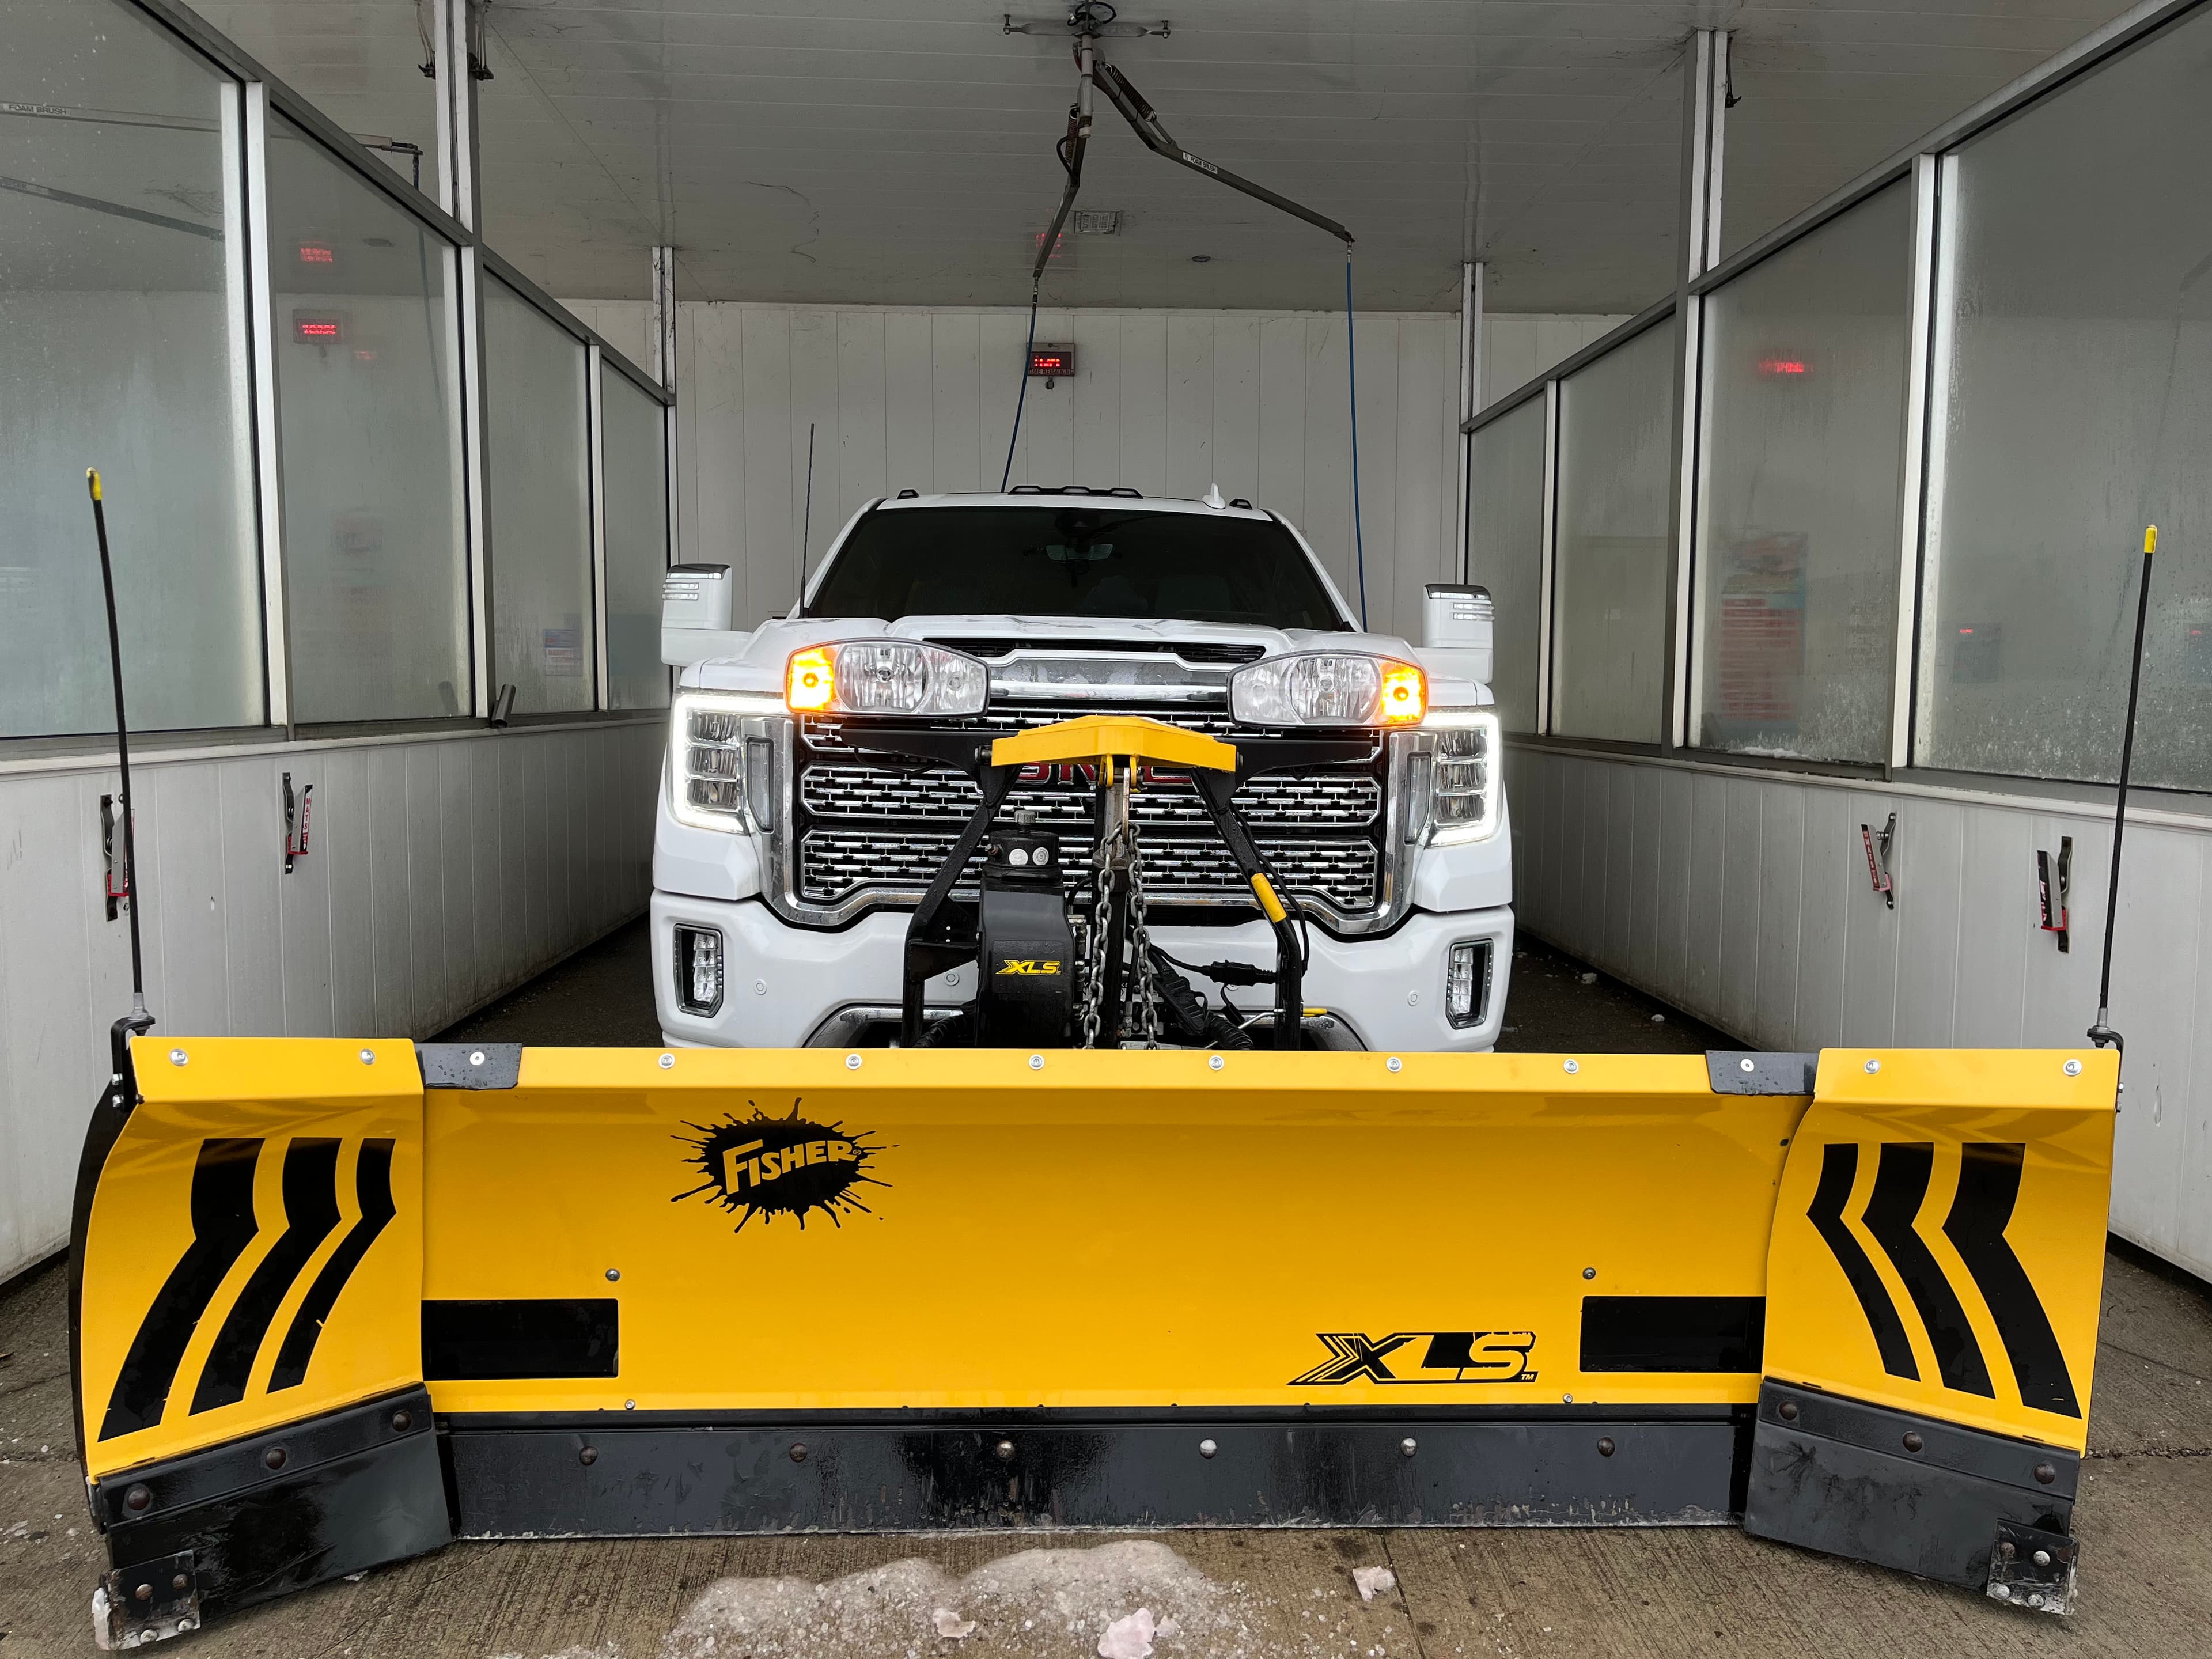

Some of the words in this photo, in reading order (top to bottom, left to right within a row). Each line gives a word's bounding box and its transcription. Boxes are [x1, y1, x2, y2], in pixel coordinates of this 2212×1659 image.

[9, 104, 34, 112] FOAM
[36, 106, 67, 115] BRUSH
[1190, 156, 1202, 166] FOAM
[1202, 161, 1216, 173] BRUSH
[995, 959, 1062, 976] XLS
[722, 1139, 858, 1195] FISHER
[1286, 1331, 1537, 1385] XLS
